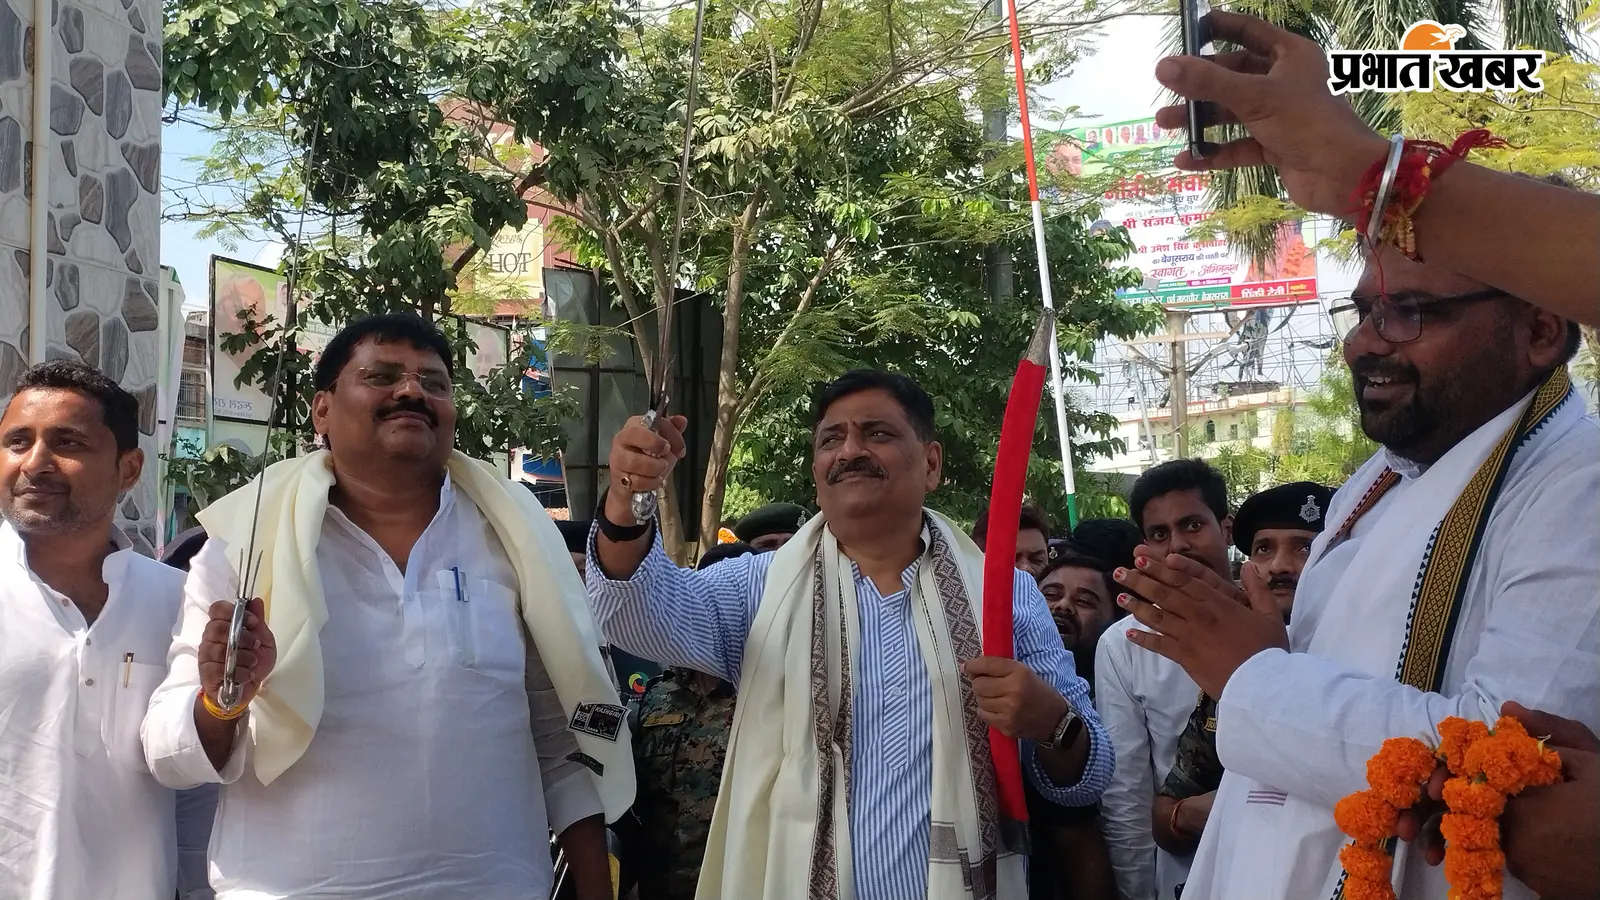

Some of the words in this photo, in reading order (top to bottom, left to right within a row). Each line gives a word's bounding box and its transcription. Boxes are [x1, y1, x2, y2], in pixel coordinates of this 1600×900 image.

[1143, 215, 1175, 227] संजय
[488, 252, 531, 274] HOT
[1150, 266, 1188, 280] स्वागत
